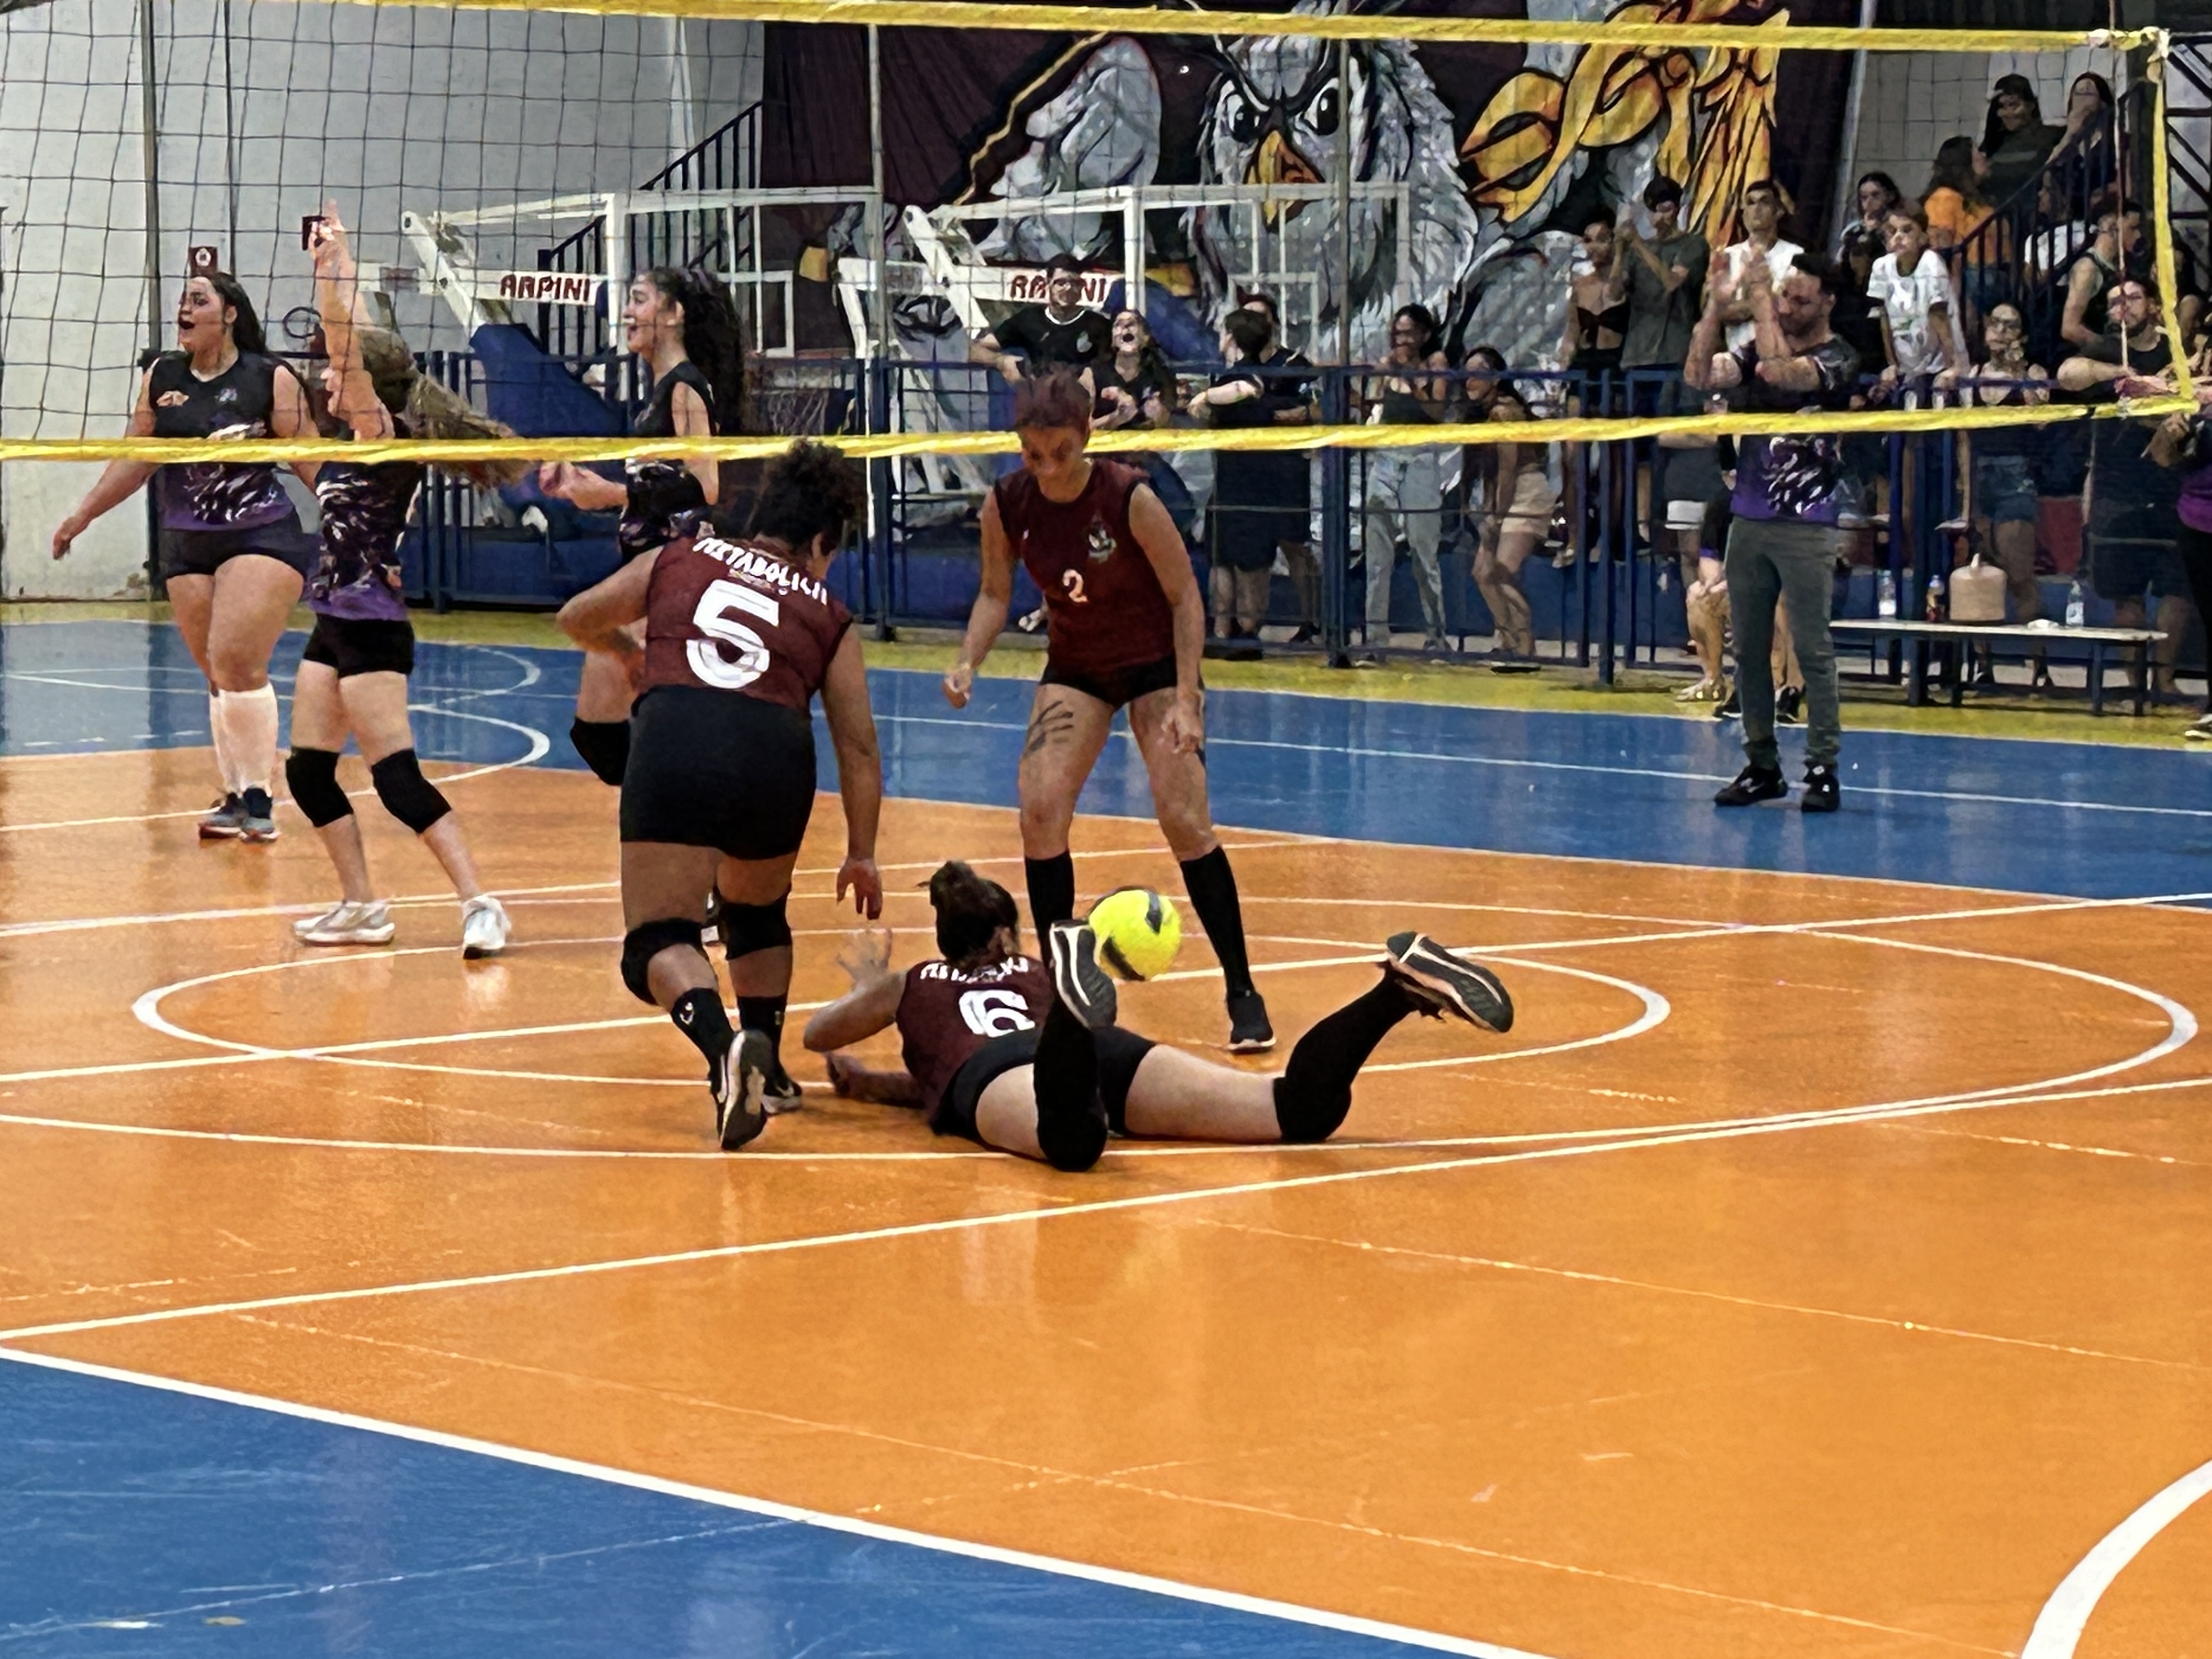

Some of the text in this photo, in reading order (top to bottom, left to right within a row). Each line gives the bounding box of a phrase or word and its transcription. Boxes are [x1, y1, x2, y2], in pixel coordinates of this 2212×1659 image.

[1062, 569, 1087, 602] 2
[686, 579, 779, 689] 5
[959, 990, 1035, 1037] 6
